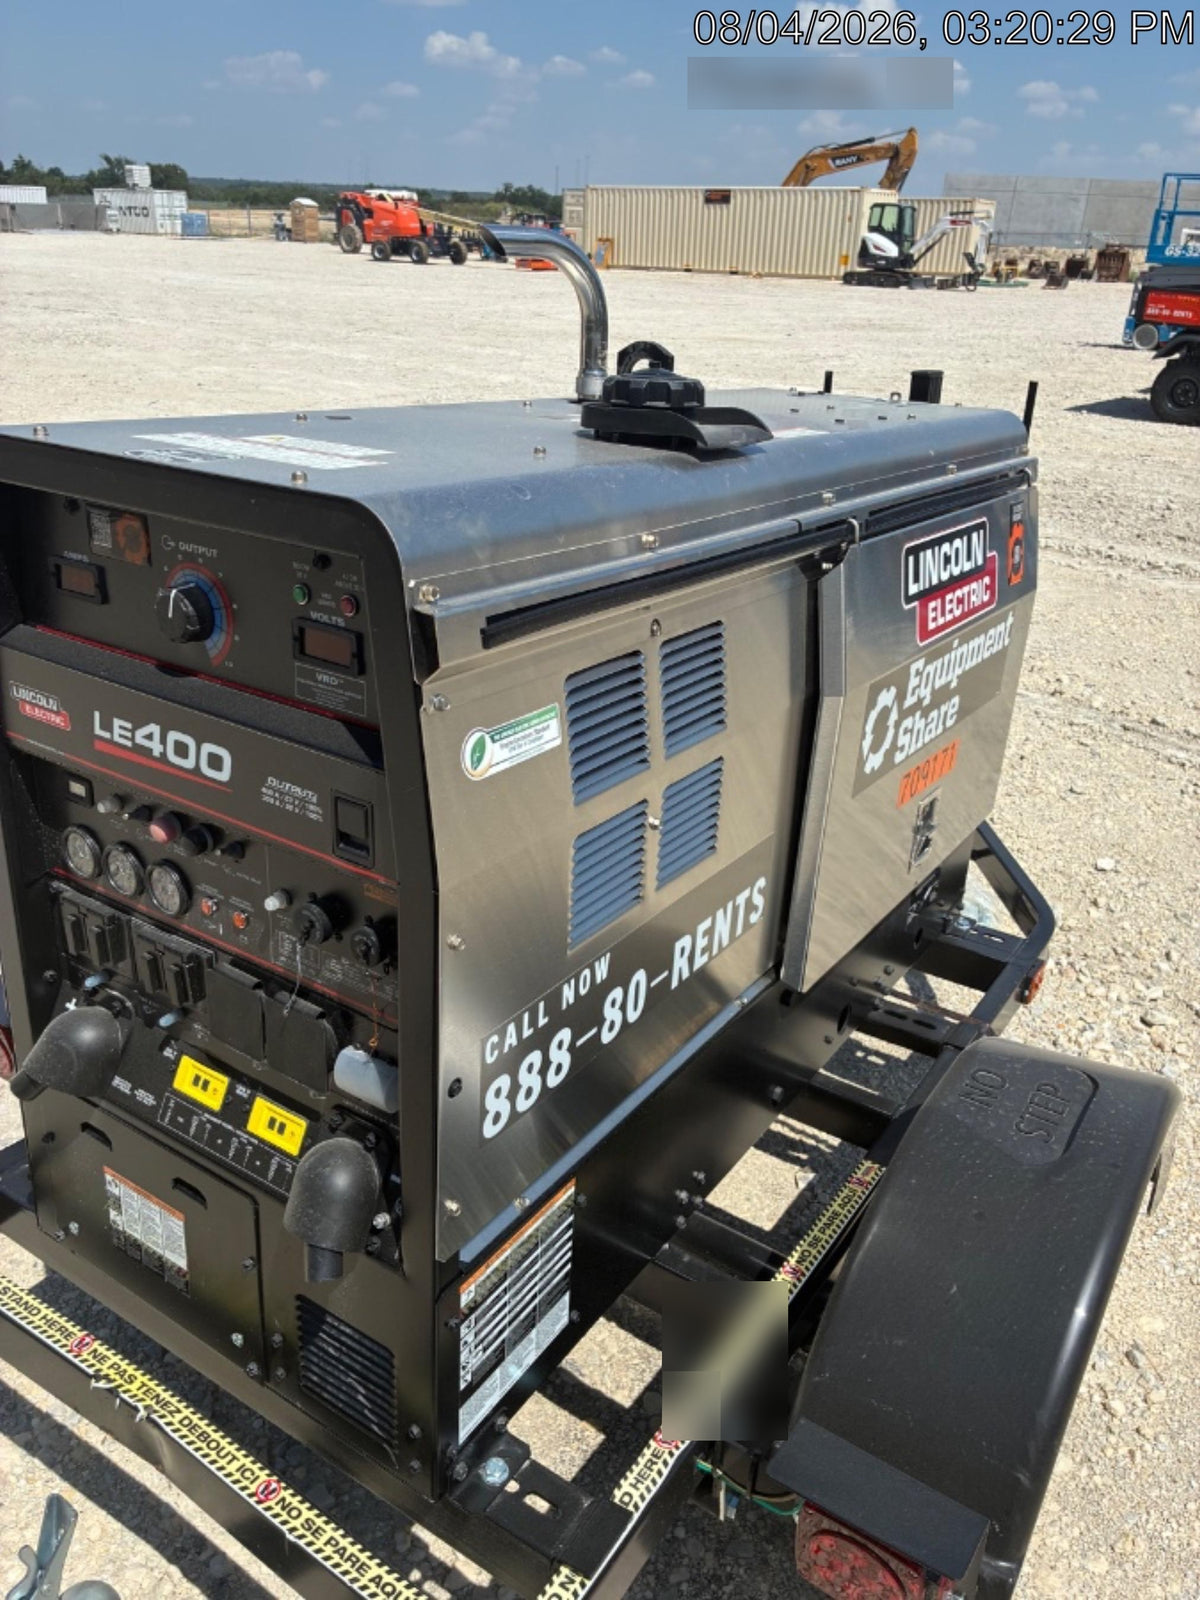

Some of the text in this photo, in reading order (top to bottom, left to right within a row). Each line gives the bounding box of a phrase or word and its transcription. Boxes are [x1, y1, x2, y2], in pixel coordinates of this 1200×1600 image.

[178, 541, 218, 558] OUTPUT
[908, 529, 985, 596] LINCOLN
[310, 611, 345, 627] VOLTS
[927, 576, 991, 632] ELECTRIC
[903, 611, 1014, 709] Equipment
[12, 687, 58, 712] LINCOLN
[25, 705, 65, 727] ELECTRIC
[894, 695, 960, 764] Share
[94, 711, 232, 782] LE400
[901, 742, 956, 803] 709171
[482, 876, 767, 1139] 888-80-RENTS
[485, 952, 611, 1064] CALL NOW
[958, 1068, 1071, 1144] NO STEP
[796, 1248, 812, 1266] NO
[808, 1234, 824, 1249] SE
[820, 1209, 841, 1235] PARE
[0, 1286, 78, 1342] STAND HERE
[89, 1348, 261, 1484] NE PAS TENEZ DEBOUT ICI
[628, 1446, 666, 1491] HERE
[275, 1496, 303, 1521] NO
[300, 1517, 327, 1541] SE
[323, 1536, 372, 1578] PARE
